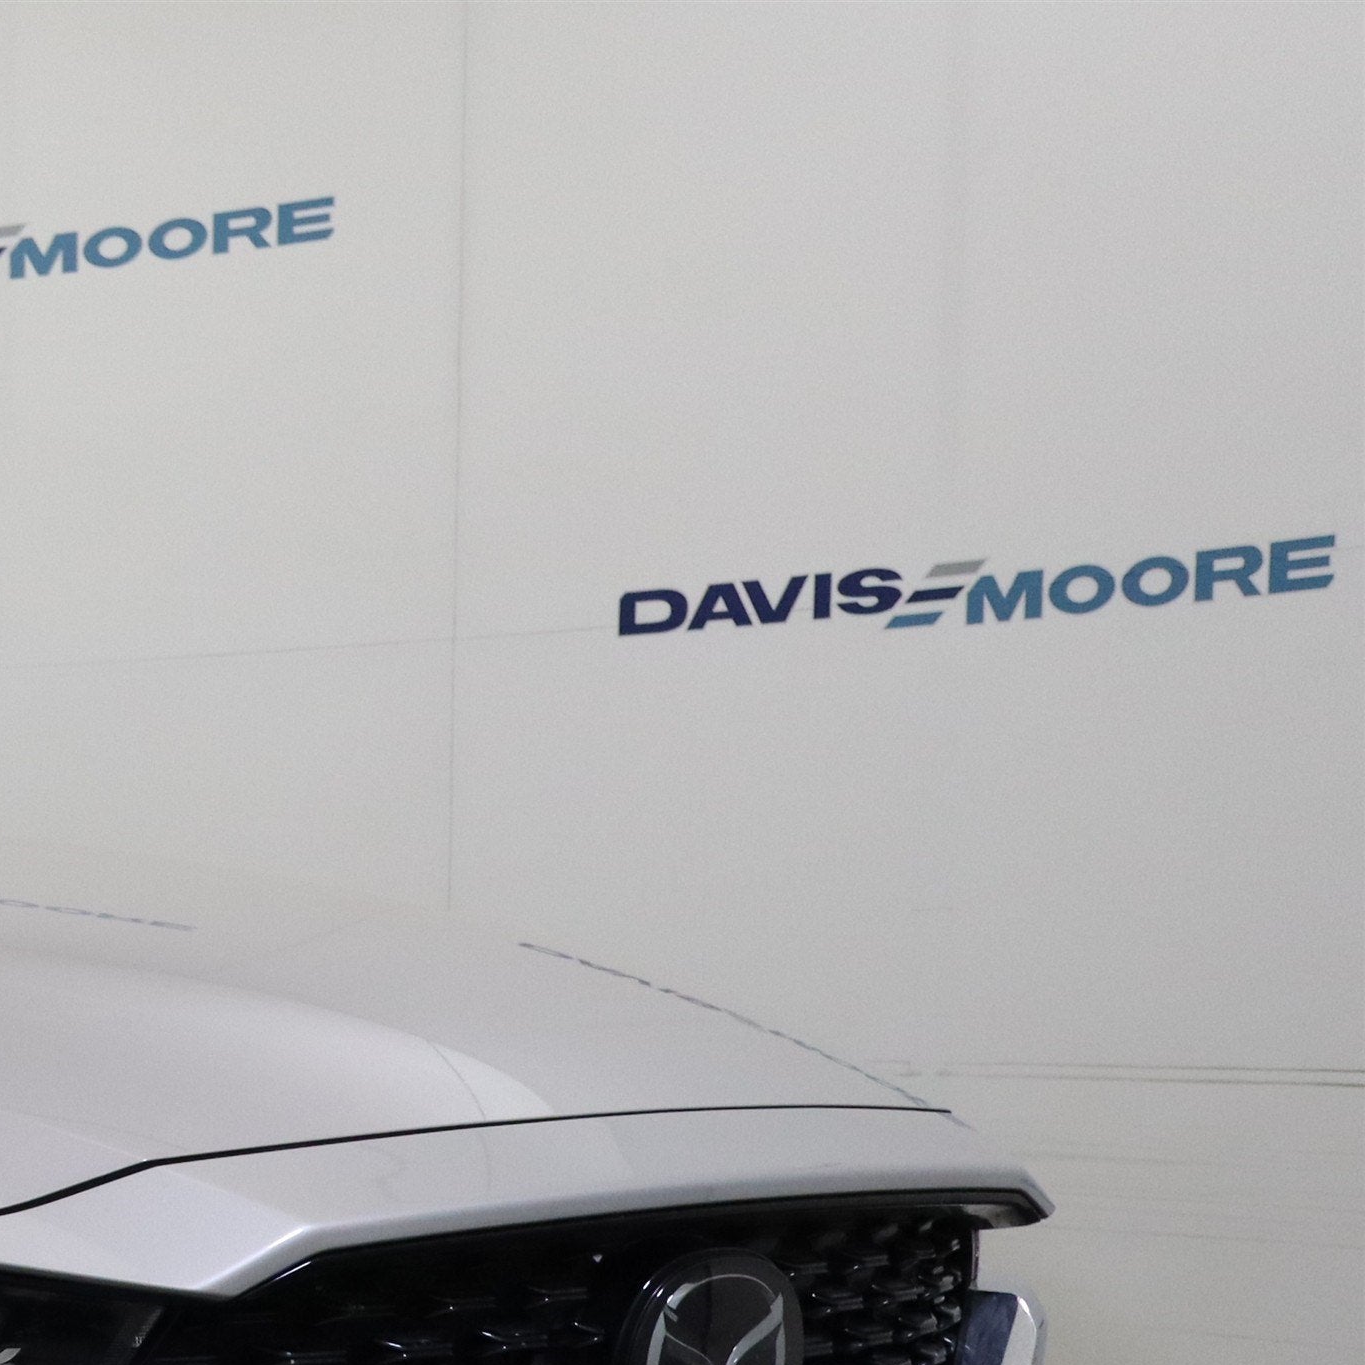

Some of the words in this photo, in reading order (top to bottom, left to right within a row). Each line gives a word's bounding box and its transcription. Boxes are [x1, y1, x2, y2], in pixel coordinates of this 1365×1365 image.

[9, 196, 336, 280] MOORE
[618, 567, 905, 636] DAVIS
[966, 534, 1336, 625] MOORE
